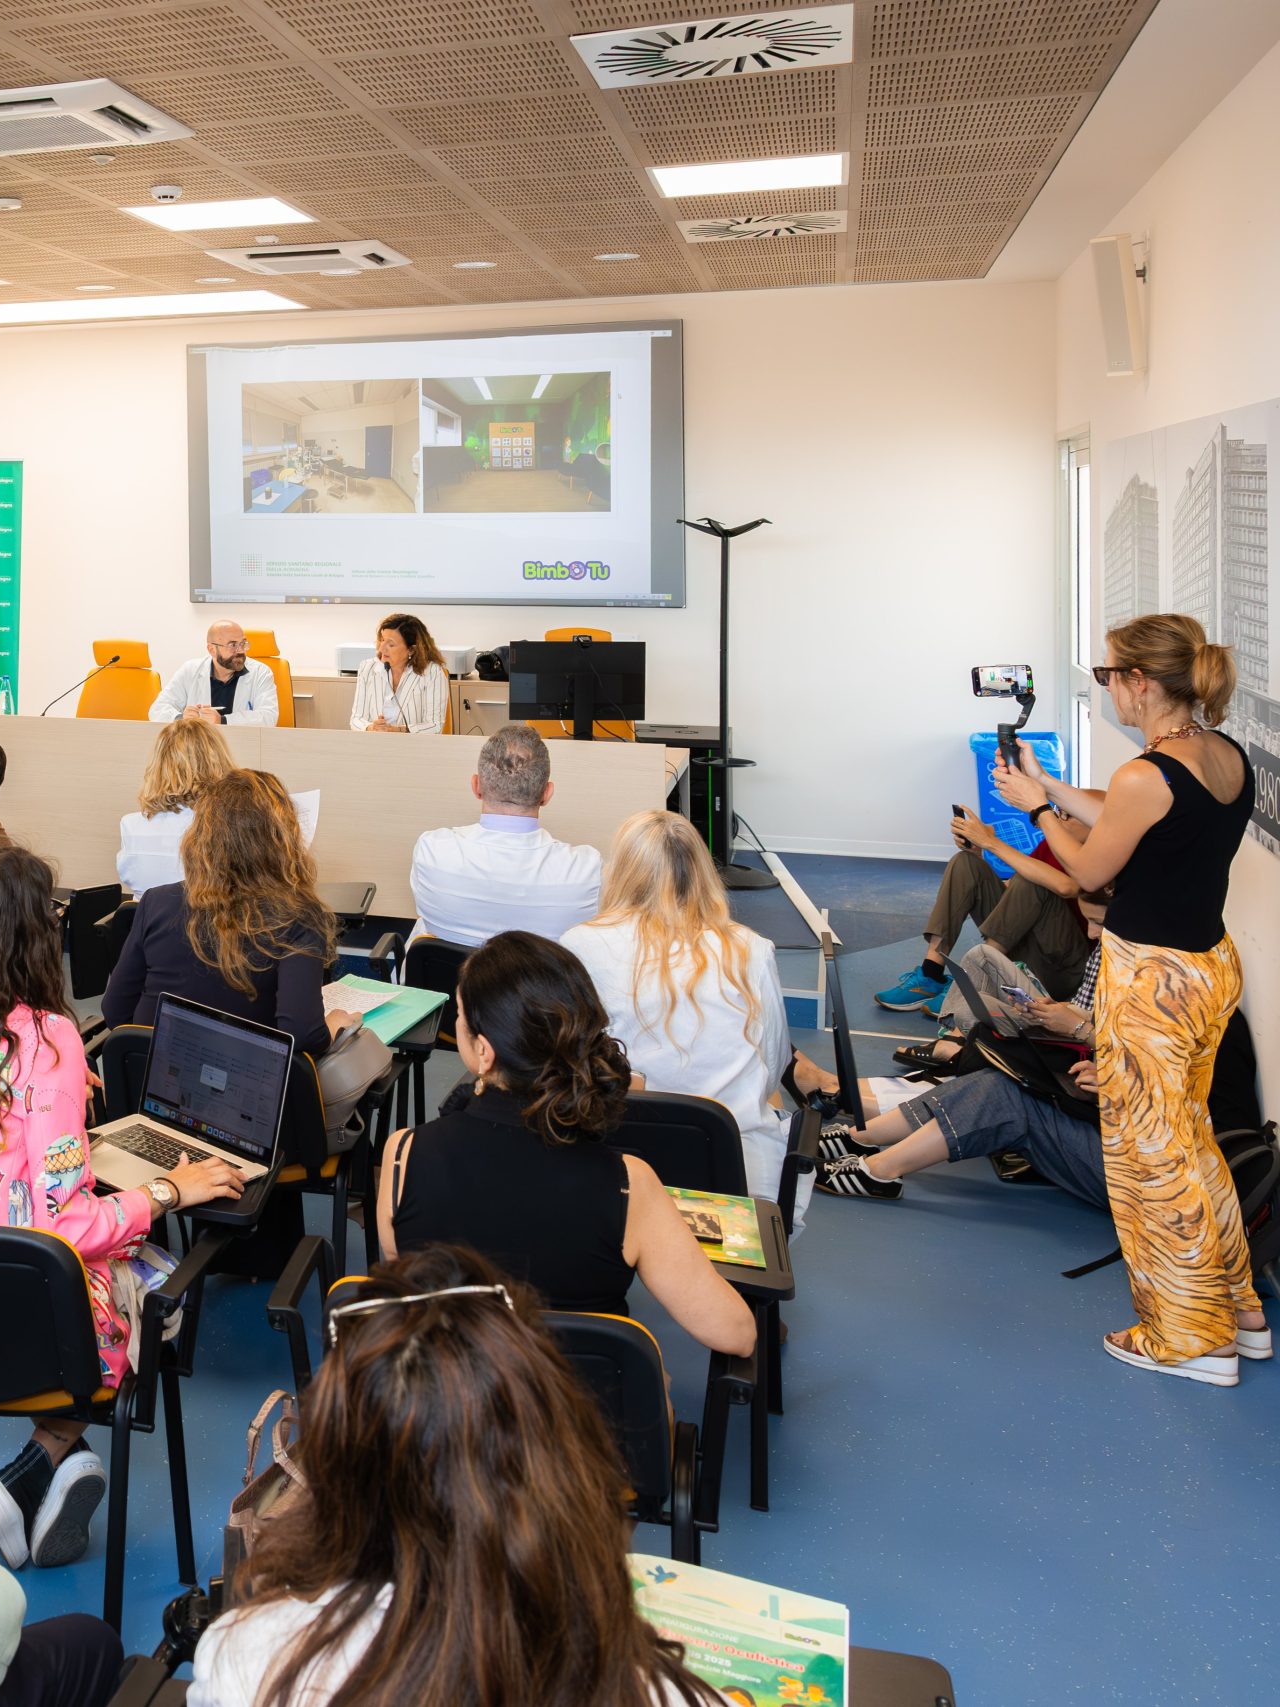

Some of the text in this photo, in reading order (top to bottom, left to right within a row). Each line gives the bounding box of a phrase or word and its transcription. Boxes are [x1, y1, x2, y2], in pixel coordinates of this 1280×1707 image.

[587, 561, 610, 580] Tu
[704, 1653, 732, 1668] 2025
[723, 1645, 805, 1673] Oculistica
